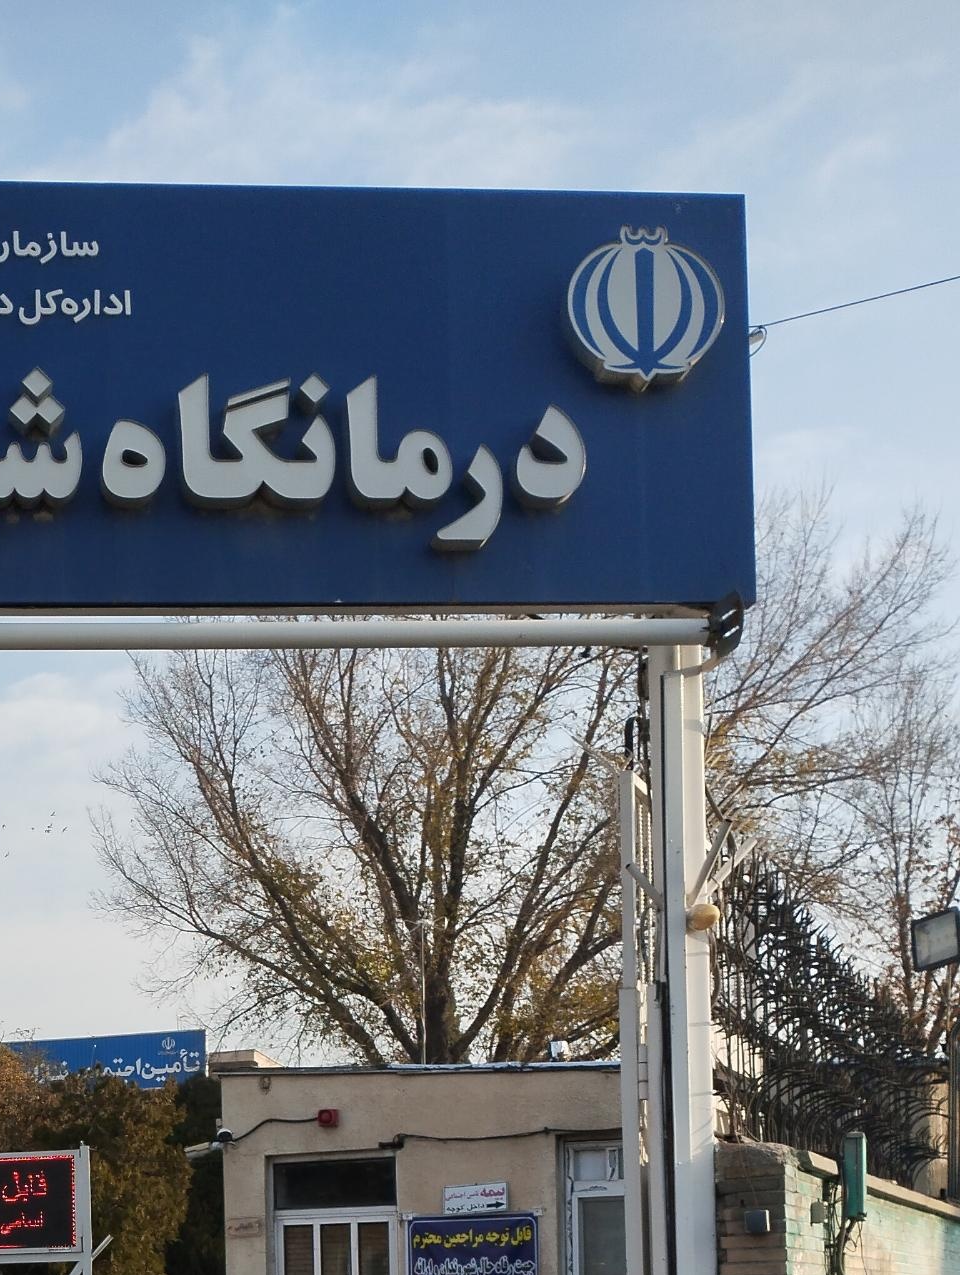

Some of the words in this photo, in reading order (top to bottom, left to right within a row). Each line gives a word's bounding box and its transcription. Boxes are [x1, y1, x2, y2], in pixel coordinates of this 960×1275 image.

[100, 370, 586, 551] درمانگاه
[141, 1049, 200, 1082] تأمین
[413, 1232, 442, 1249] محترم
[444, 1228, 484, 1249] مراجعین
[485, 1228, 510, 1247] توجه
[511, 1225, 532, 1246] قابل
